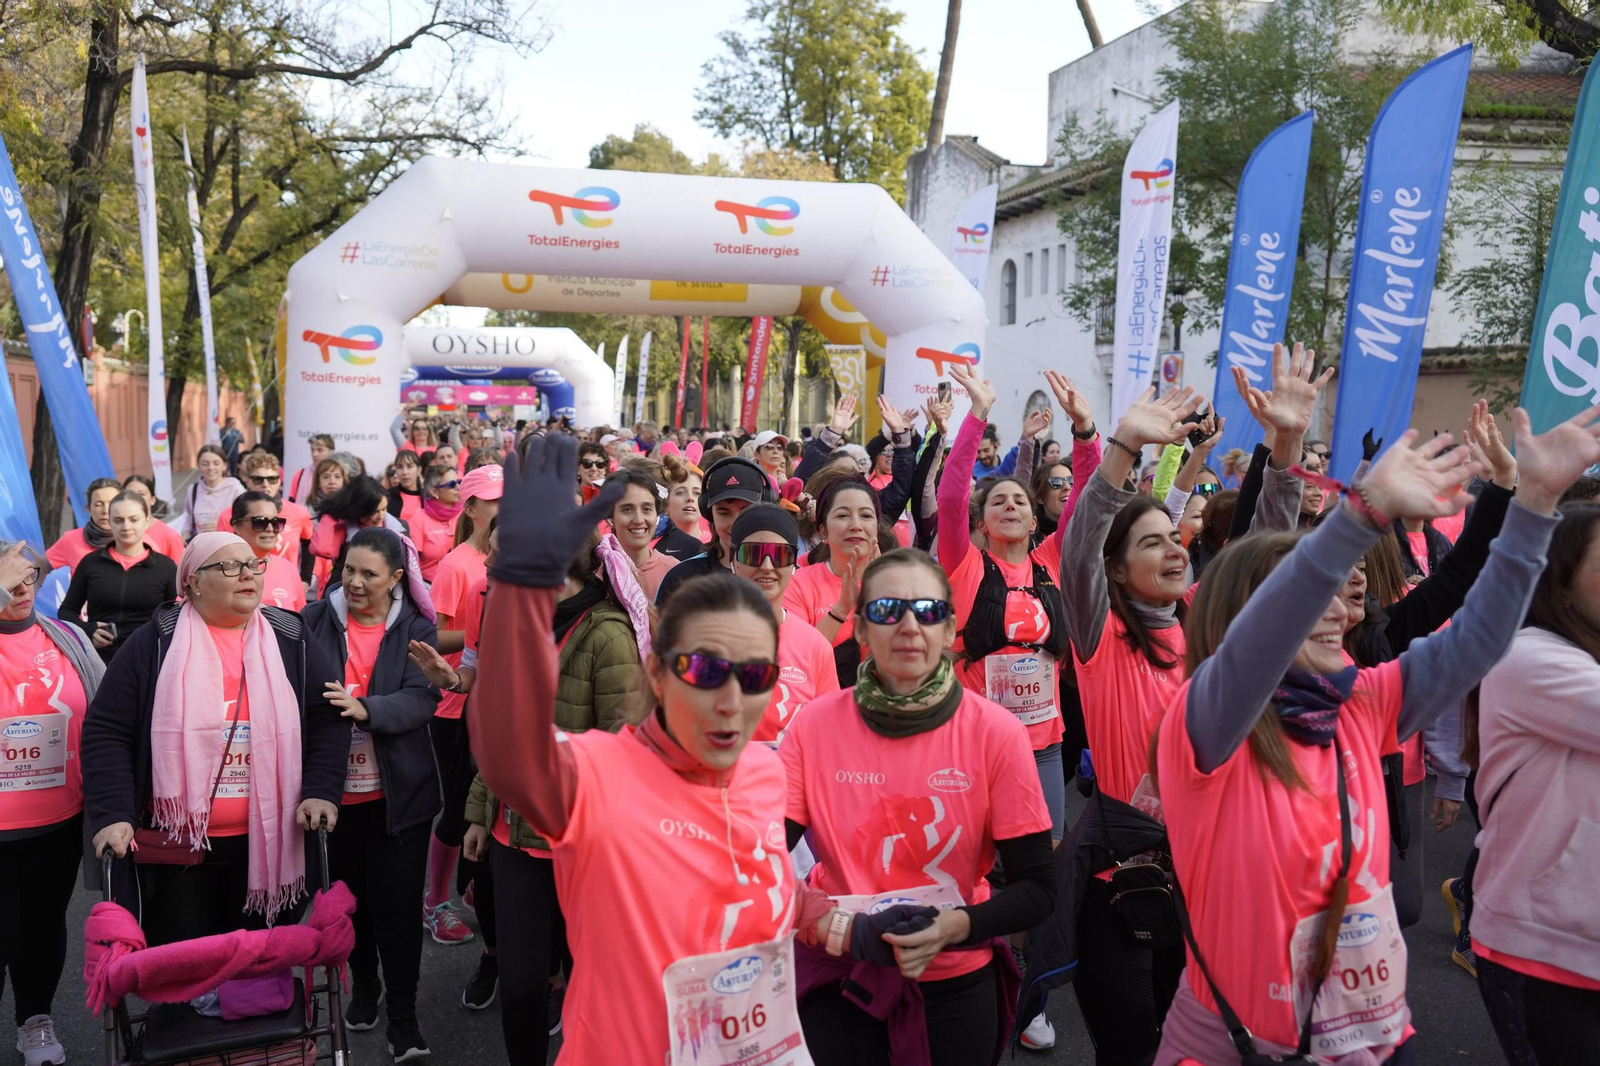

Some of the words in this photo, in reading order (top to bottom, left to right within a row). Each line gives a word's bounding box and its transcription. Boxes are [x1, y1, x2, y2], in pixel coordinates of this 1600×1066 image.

[527, 234, 620, 251] TotalEnergies
[713, 242, 800, 258] TotalEnergies
[1354, 186, 1432, 362] Marlene
[589, 276, 636, 288] Municipal
[690, 281, 723, 289] SEVILLA
[561, 287, 574, 296] de
[577, 288, 621, 298] Deportes
[1227, 231, 1286, 382] Marlene
[433, 334, 535, 354] OYSHO
[748, 316, 767, 384] Santander
[301, 371, 382, 387] TotalEnergies
[1014, 682, 1040, 696] 016
[5, 727, 40, 735] ASTURIANA
[6, 746, 41, 761] 016
[224, 753, 251, 766] 016
[347, 753, 366, 765] 16
[31, 777, 58, 786] Santander
[835, 770, 886, 785] OYSHO
[1341, 958, 1389, 991] 016
[676, 985, 707, 998] SUMA
[1365, 995, 1382, 1008] 747
[721, 1003, 767, 1040] 016
[1321, 1015, 1351, 1031] CARRERA
[1352, 1013, 1362, 1022] DE
[1363, 1011, 1373, 1020] LA
[1318, 1029, 1364, 1049] OYSHO
